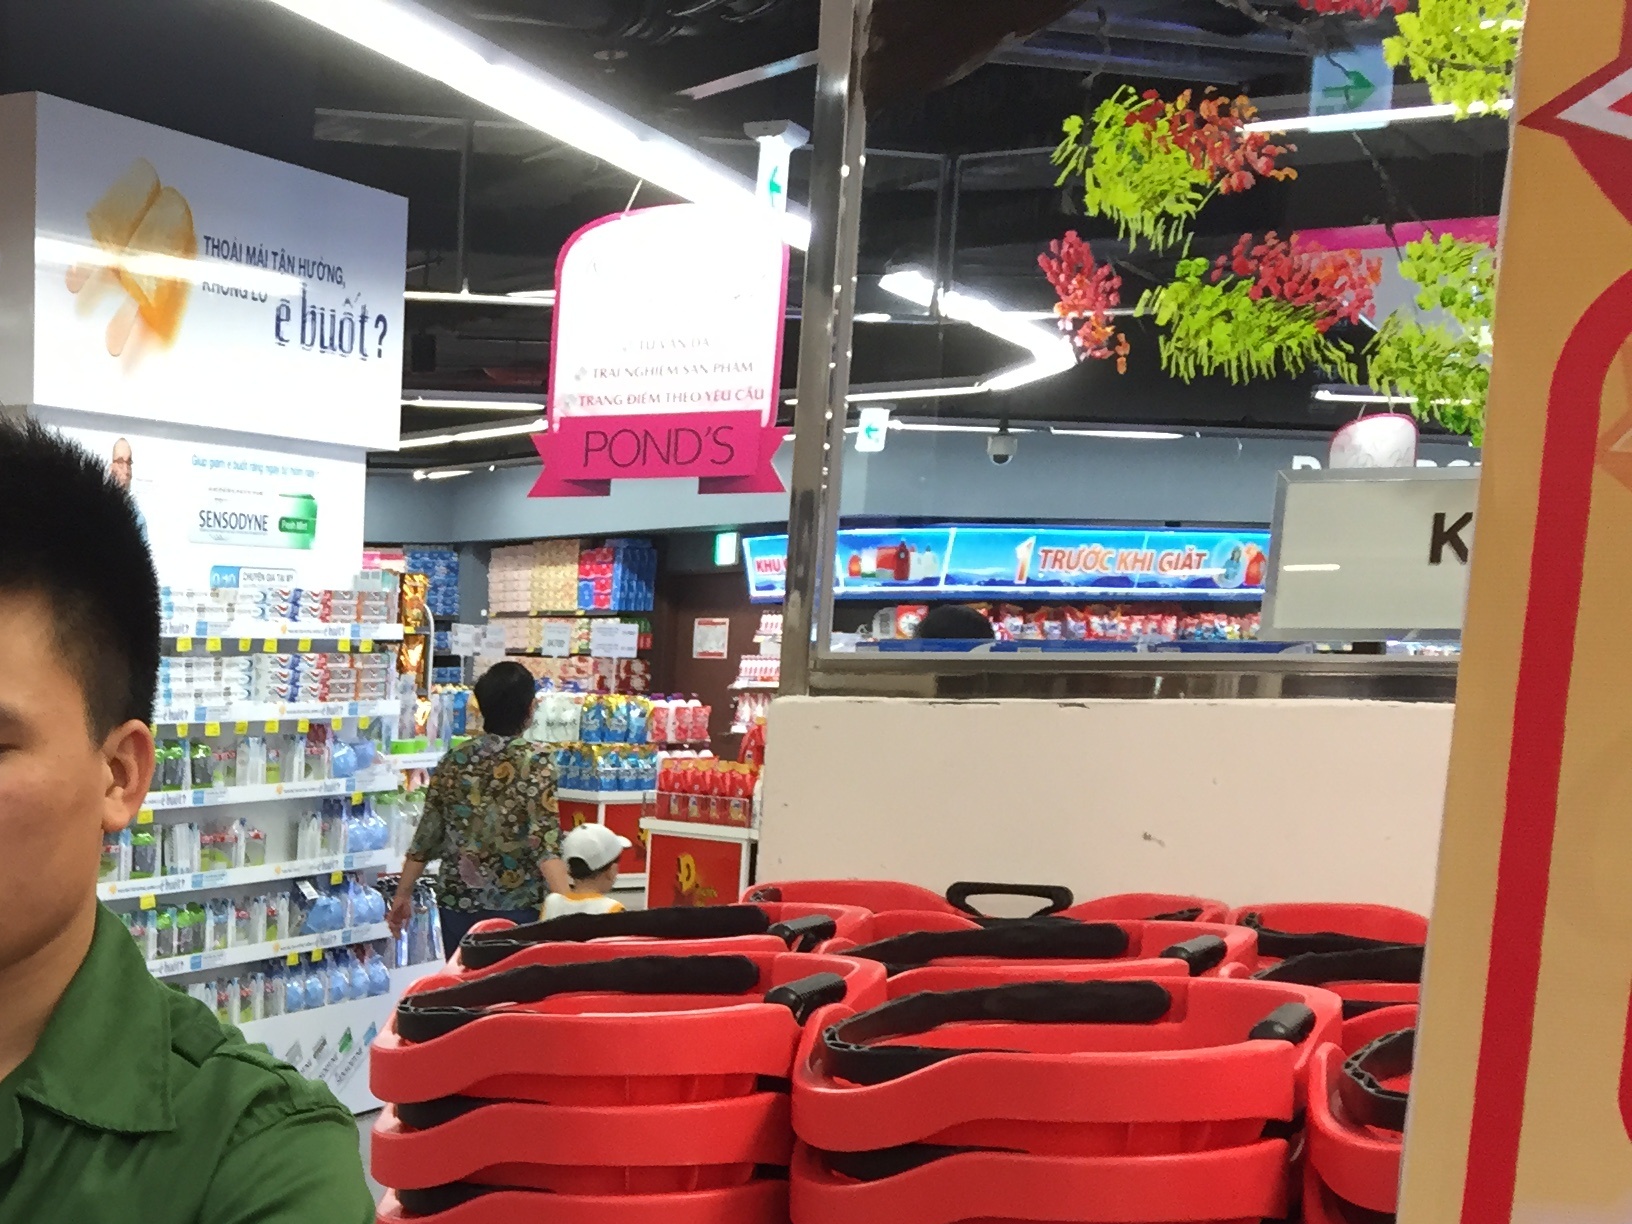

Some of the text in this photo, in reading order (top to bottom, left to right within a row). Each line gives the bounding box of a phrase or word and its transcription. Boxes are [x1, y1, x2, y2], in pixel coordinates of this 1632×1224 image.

[246, 243, 268, 269] MÁI
[271, 248, 295, 275] TẬN
[198, 509, 269, 533] SENSODYNE
[756, 559, 781, 573] KHU
[1040, 543, 1115, 572] TRƯỚC
[1118, 552, 1154, 572] KHI
